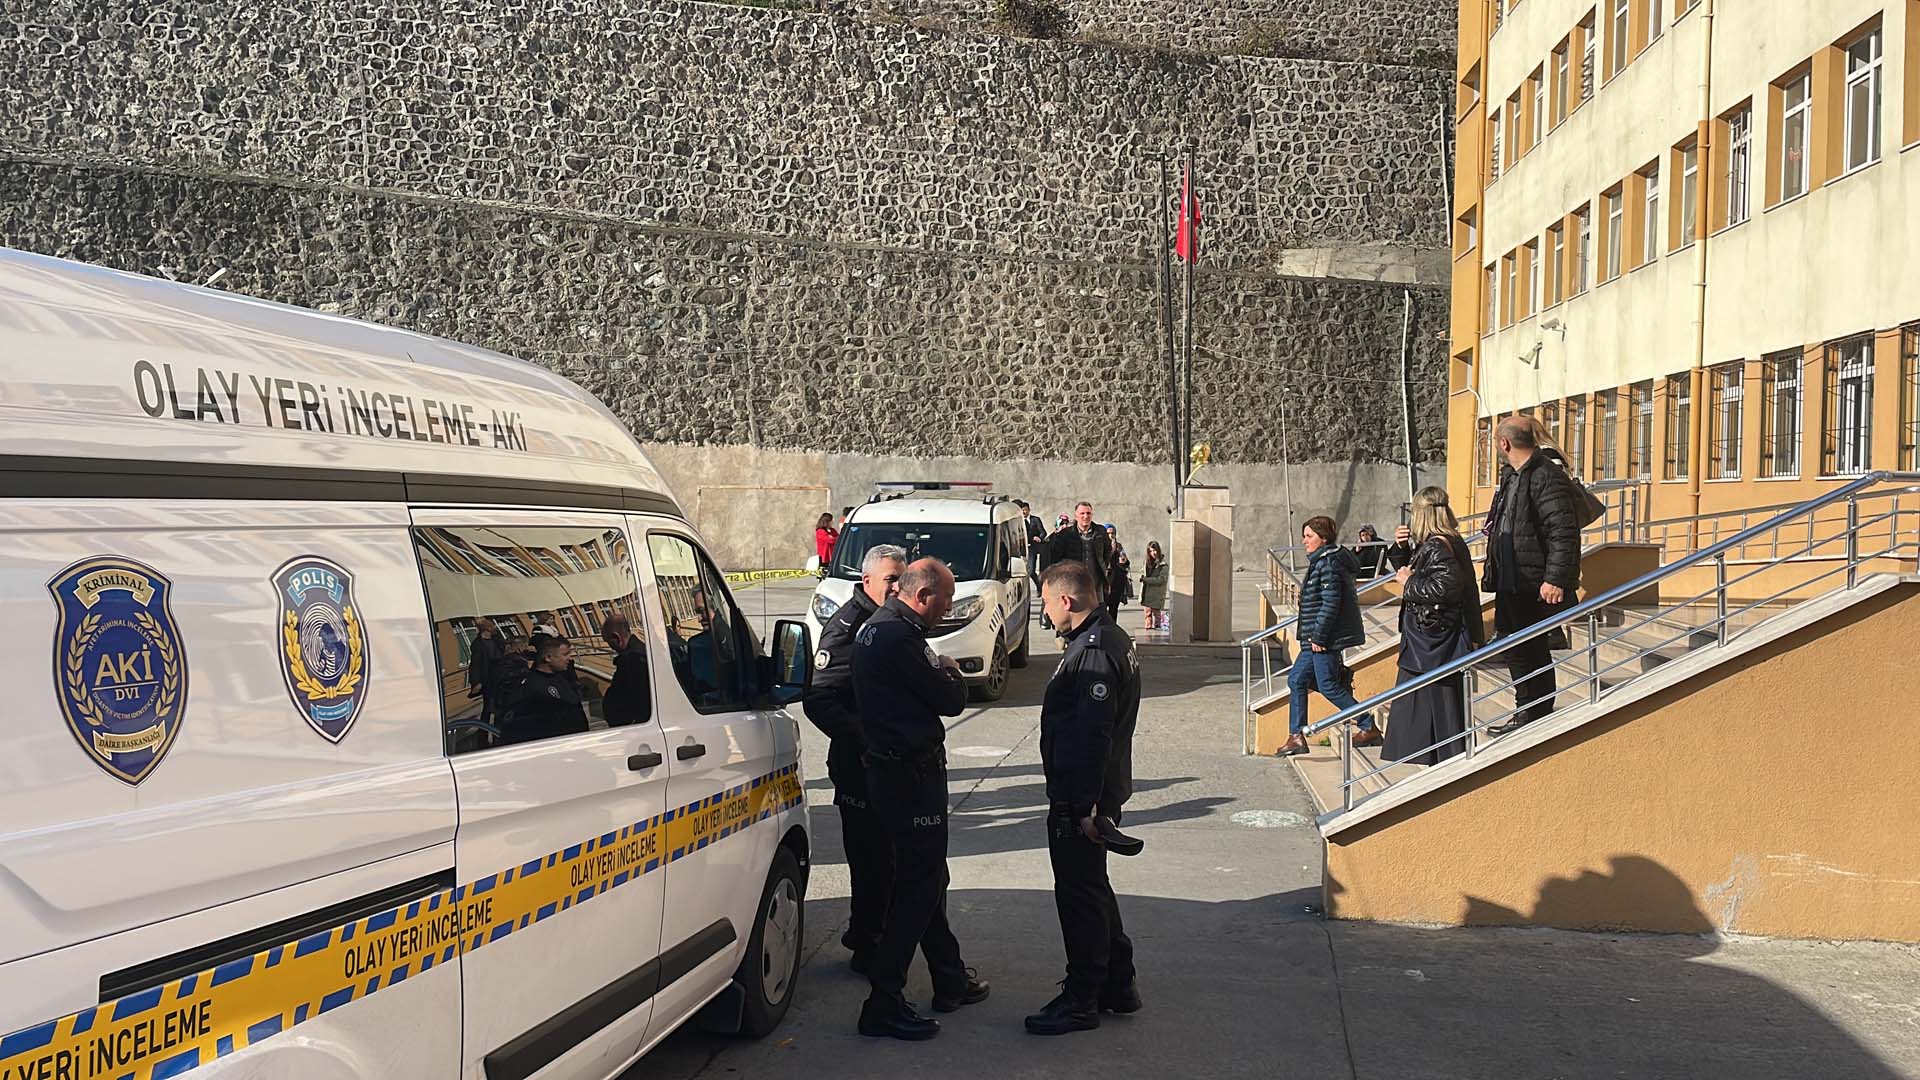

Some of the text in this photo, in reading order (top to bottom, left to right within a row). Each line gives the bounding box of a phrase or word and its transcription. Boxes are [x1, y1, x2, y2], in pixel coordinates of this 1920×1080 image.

[133, 359, 240, 424] OLAY
[115, 686, 140, 701] DVI
[693, 813, 709, 836] OLAY
[570, 856, 595, 887] OLAY
[344, 936, 387, 978] OLAY
